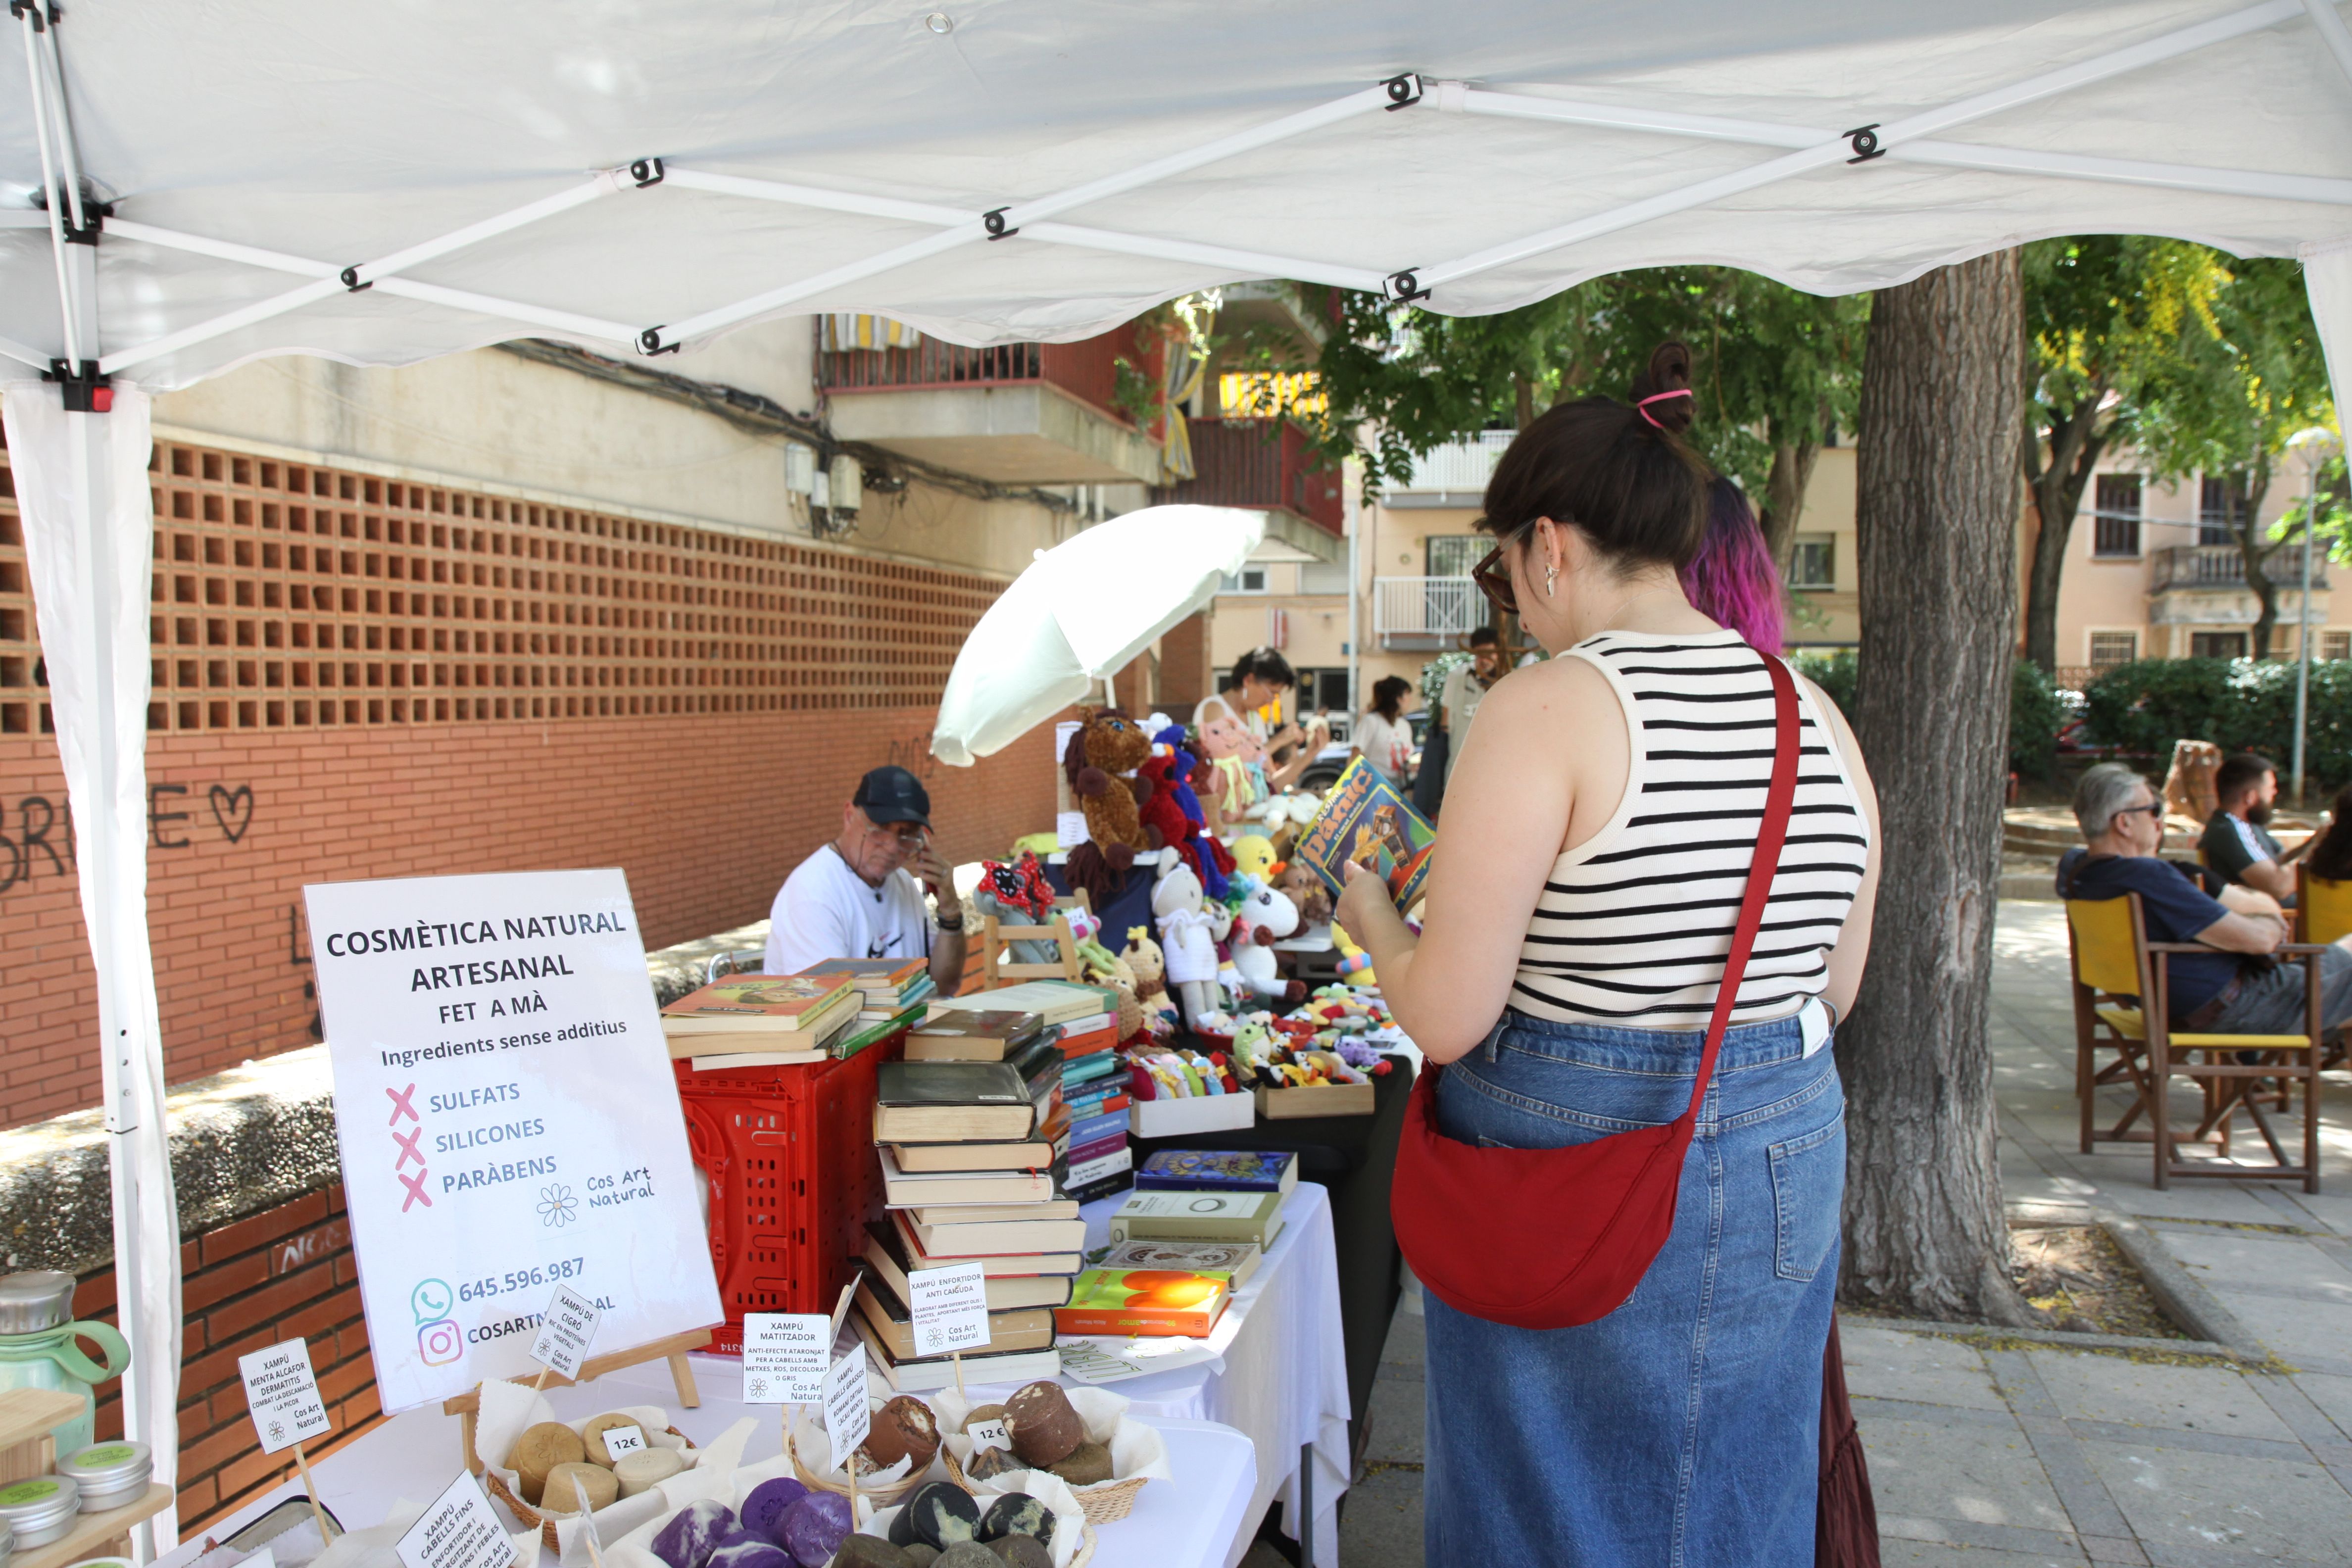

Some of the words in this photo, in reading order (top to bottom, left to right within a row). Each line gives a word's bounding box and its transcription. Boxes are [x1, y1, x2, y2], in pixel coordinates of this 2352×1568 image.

[327, 920, 498, 957] COSMÈTICA
[503, 911, 627, 940] NATURAL
[411, 954, 574, 992] ARTESANAL
[439, 1002, 477, 1024] FET
[491, 999, 506, 1018] A
[512, 990, 548, 1015] MÀ
[381, 1036, 494, 1068] Ingredients
[500, 1029, 551, 1049] sense
[558, 1019, 627, 1041] additius
[430, 1083, 520, 1113] SULFATS
[436, 1118, 544, 1152] SILICONES
[442, 1156, 557, 1193] PARÀBENS
[587, 1175, 614, 1191] Cos
[623, 1167, 651, 1184] Art
[589, 1181, 655, 1208] Natural
[459, 1257, 584, 1302] 645.596.987
[911, 1279, 935, 1289] XAMPÚ
[939, 1274, 981, 1285] ENFORTIDOR
[944, 1285, 974, 1295] CAIGUDA
[560, 1295, 584, 1315] XAMPÚ
[584, 1311, 593, 1322] DE
[562, 1313, 582, 1330] CIGRÓ
[771, 1321, 803, 1330] XAMPÚ
[554, 1333, 574, 1350] VEGETALS
[949, 1331, 978, 1343] Natural
[263, 1353, 289, 1371] XAMPÚ
[551, 1357, 569, 1372] Natural
[554, 1350, 563, 1359] Cos
[563, 1355, 572, 1365] Art
[250, 1373, 274, 1387] MENTA
[276, 1362, 306, 1378] ALCAFOR
[261, 1376, 300, 1396] DERMATITIS
[837, 1363, 854, 1385] XAMPÚ
[252, 1397, 274, 1409] COMBAT
[283, 1381, 314, 1398] DESCAMACIÓ
[828, 1385, 846, 1407] CABELLS
[846, 1368, 865, 1391] GRASSOS
[285, 1398, 299, 1408] PICOR
[294, 1409, 307, 1418] Cos
[309, 1404, 319, 1413] Art
[833, 1399, 849, 1418] ROMANÍ
[849, 1385, 864, 1403] ORTIGA
[837, 1409, 850, 1427] CACAU
[850, 1398, 864, 1417] MENTA
[297, 1413, 324, 1429] Natural
[851, 1418, 867, 1442] Natural
[614, 1437, 638, 1449] 12€
[980, 1430, 994, 1439] 12
[421, 1519, 455, 1559] CABELLS
[455, 1499, 474, 1522] FINS
[424, 1503, 454, 1540] XAMPÚ
[477, 1523, 487, 1534] DE
[432, 1522, 473, 1568] ENFORTIDOR
[459, 1552, 475, 1568] FINS
[477, 1524, 499, 1550] FEBLES
[492, 1541, 505, 1558] Art
